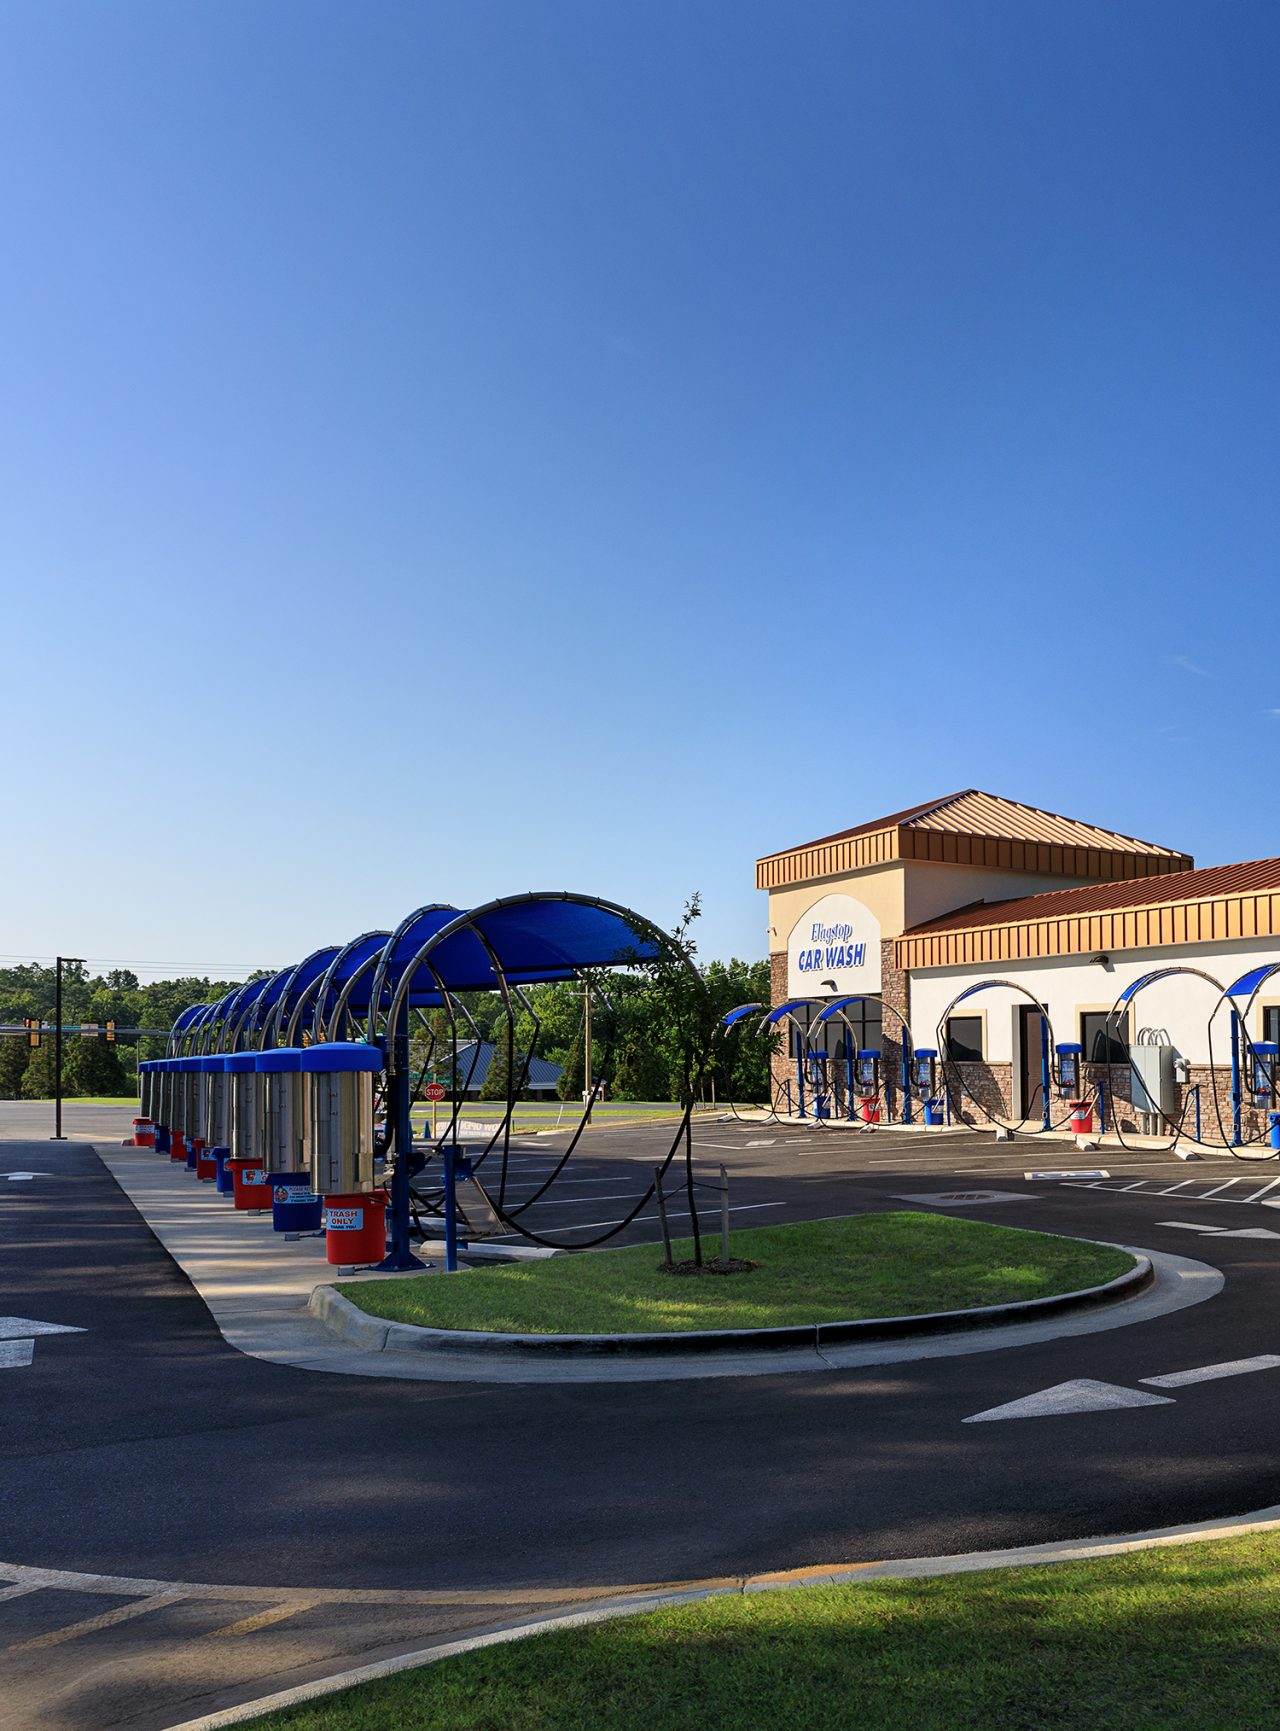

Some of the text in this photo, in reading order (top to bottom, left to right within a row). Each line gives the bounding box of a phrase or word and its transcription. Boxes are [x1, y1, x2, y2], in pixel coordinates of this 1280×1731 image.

[811, 923, 852, 945] Flagstop
[799, 943, 865, 972] CAR WASH
[426, 1088, 444, 1096] STOP
